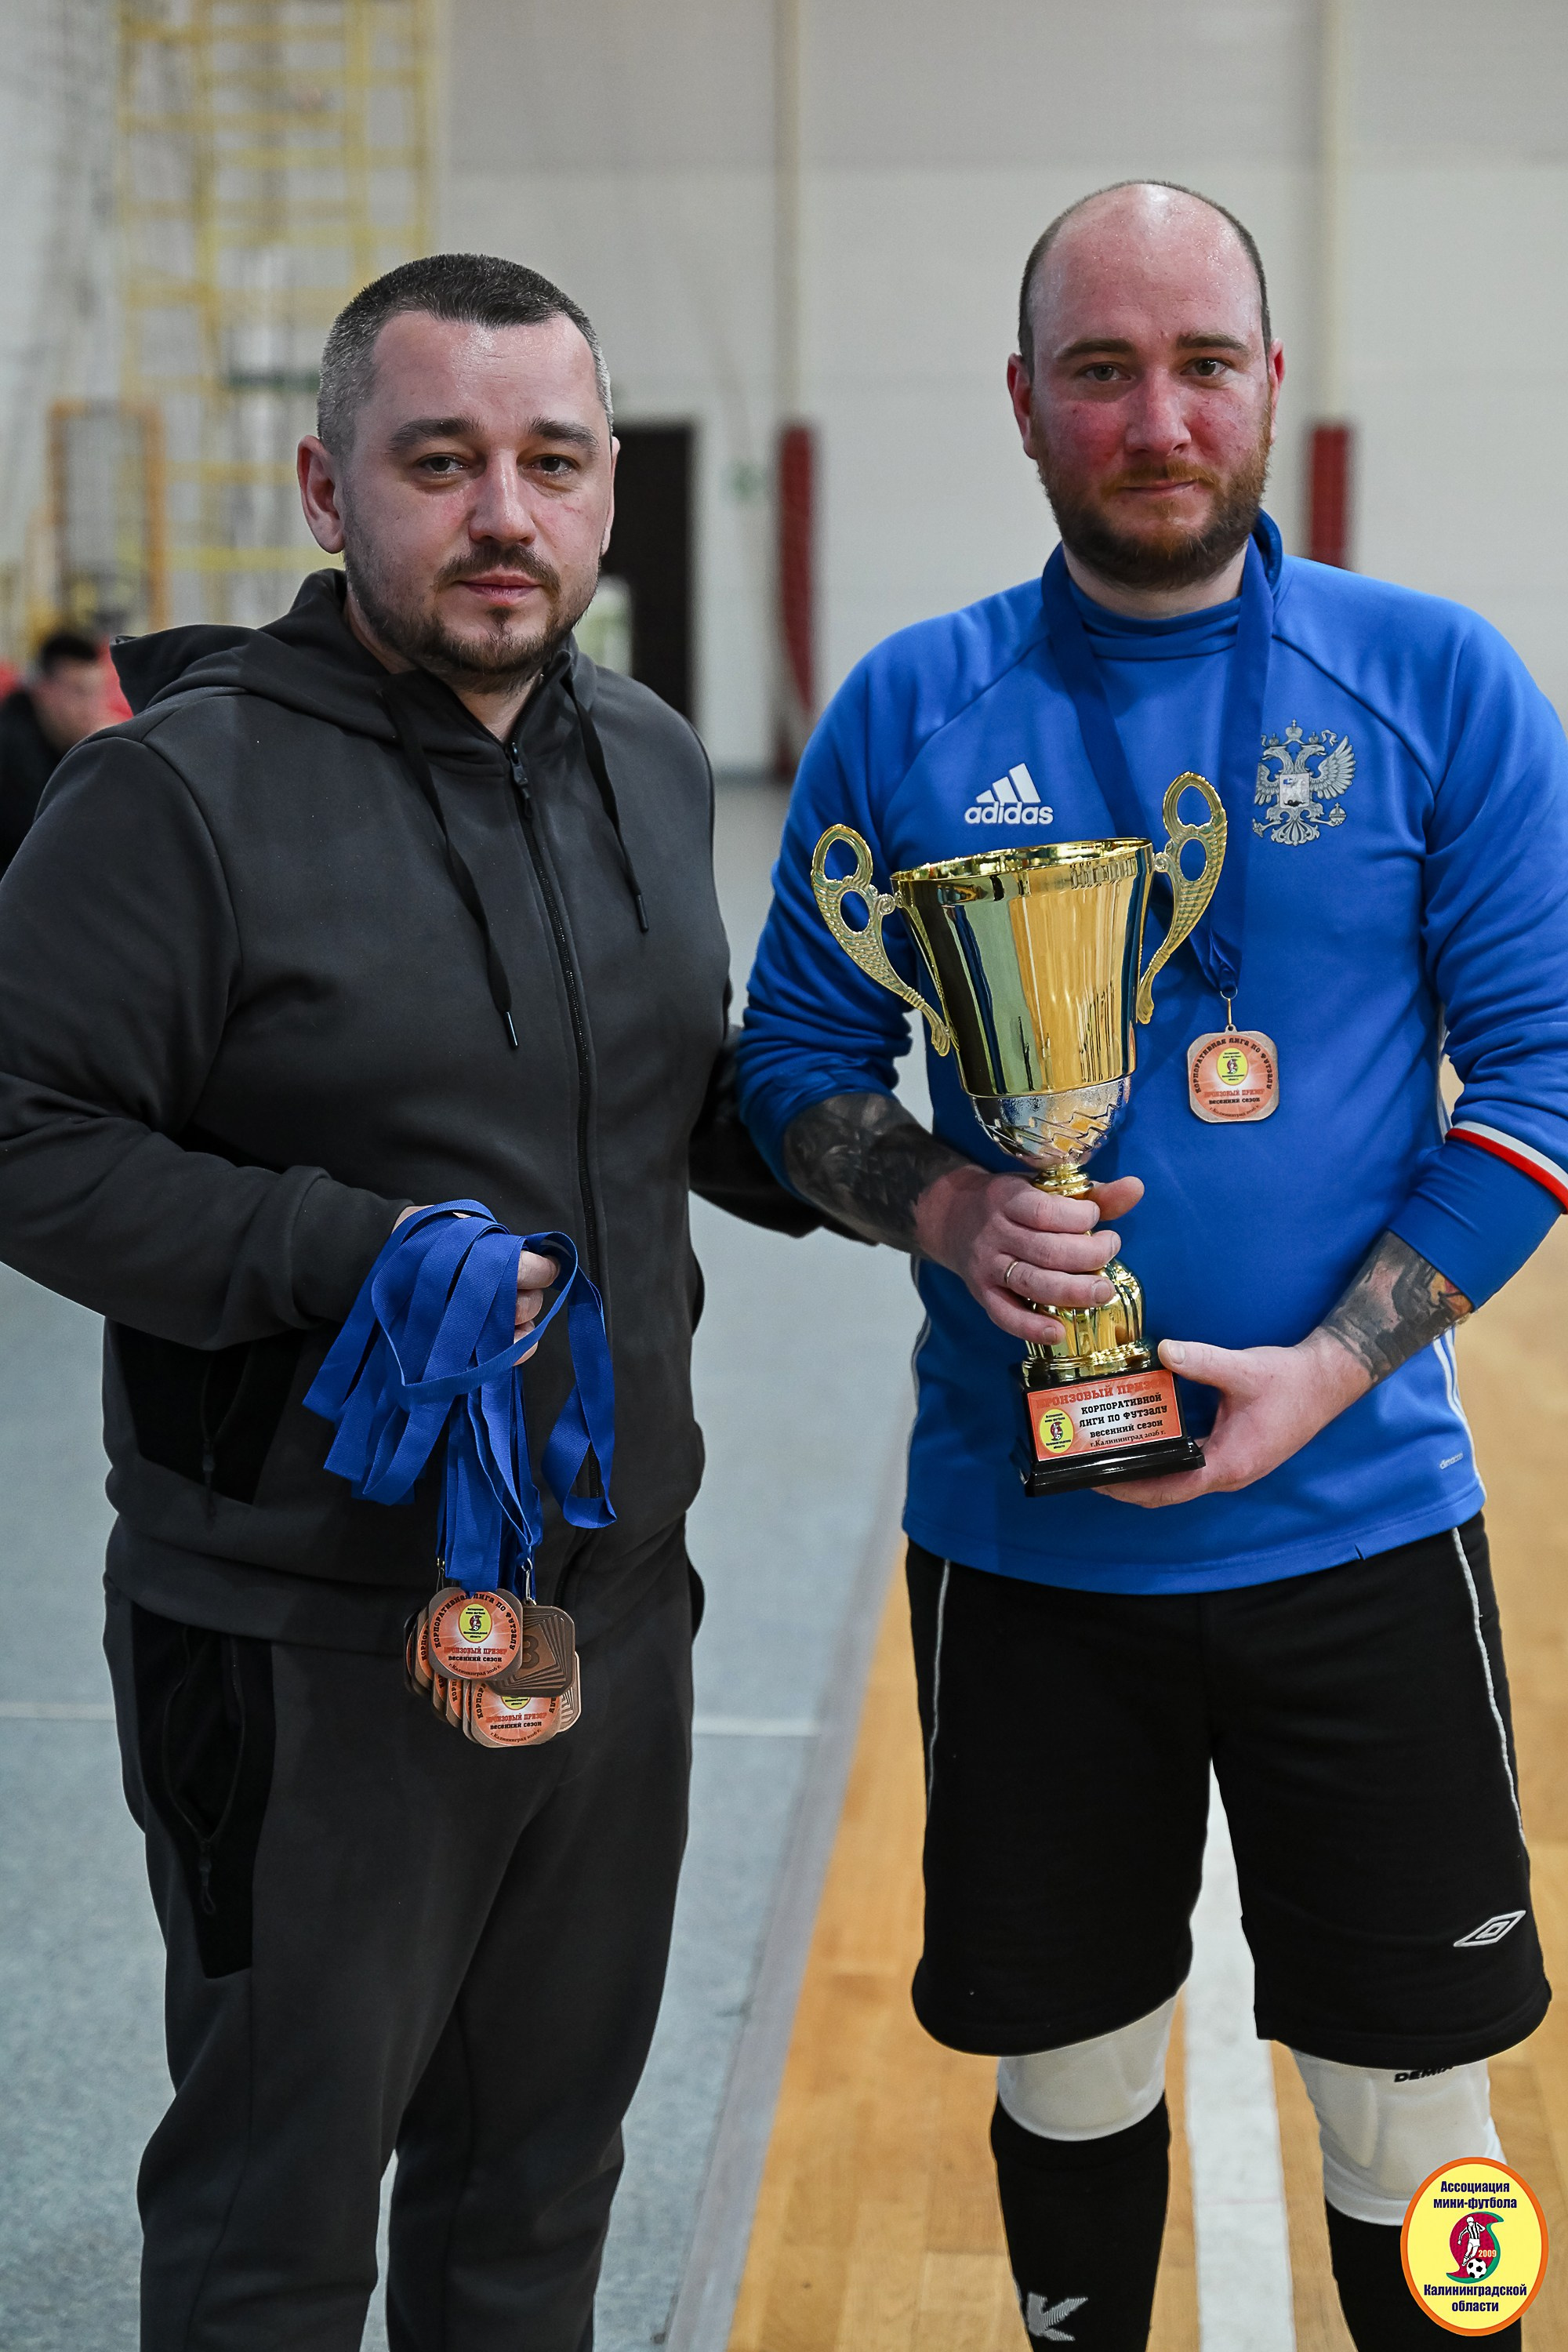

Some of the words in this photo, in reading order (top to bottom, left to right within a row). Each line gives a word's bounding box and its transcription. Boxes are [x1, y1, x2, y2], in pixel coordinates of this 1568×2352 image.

[964, 801, 1054, 825] adidas
[1081, 1392, 1162, 1414] КОРПОРАТИВНОЙ
[1080, 1417, 1105, 1428] ЛИГИ
[433, 1594, 467, 1648] КОРПОРАТИВНА
